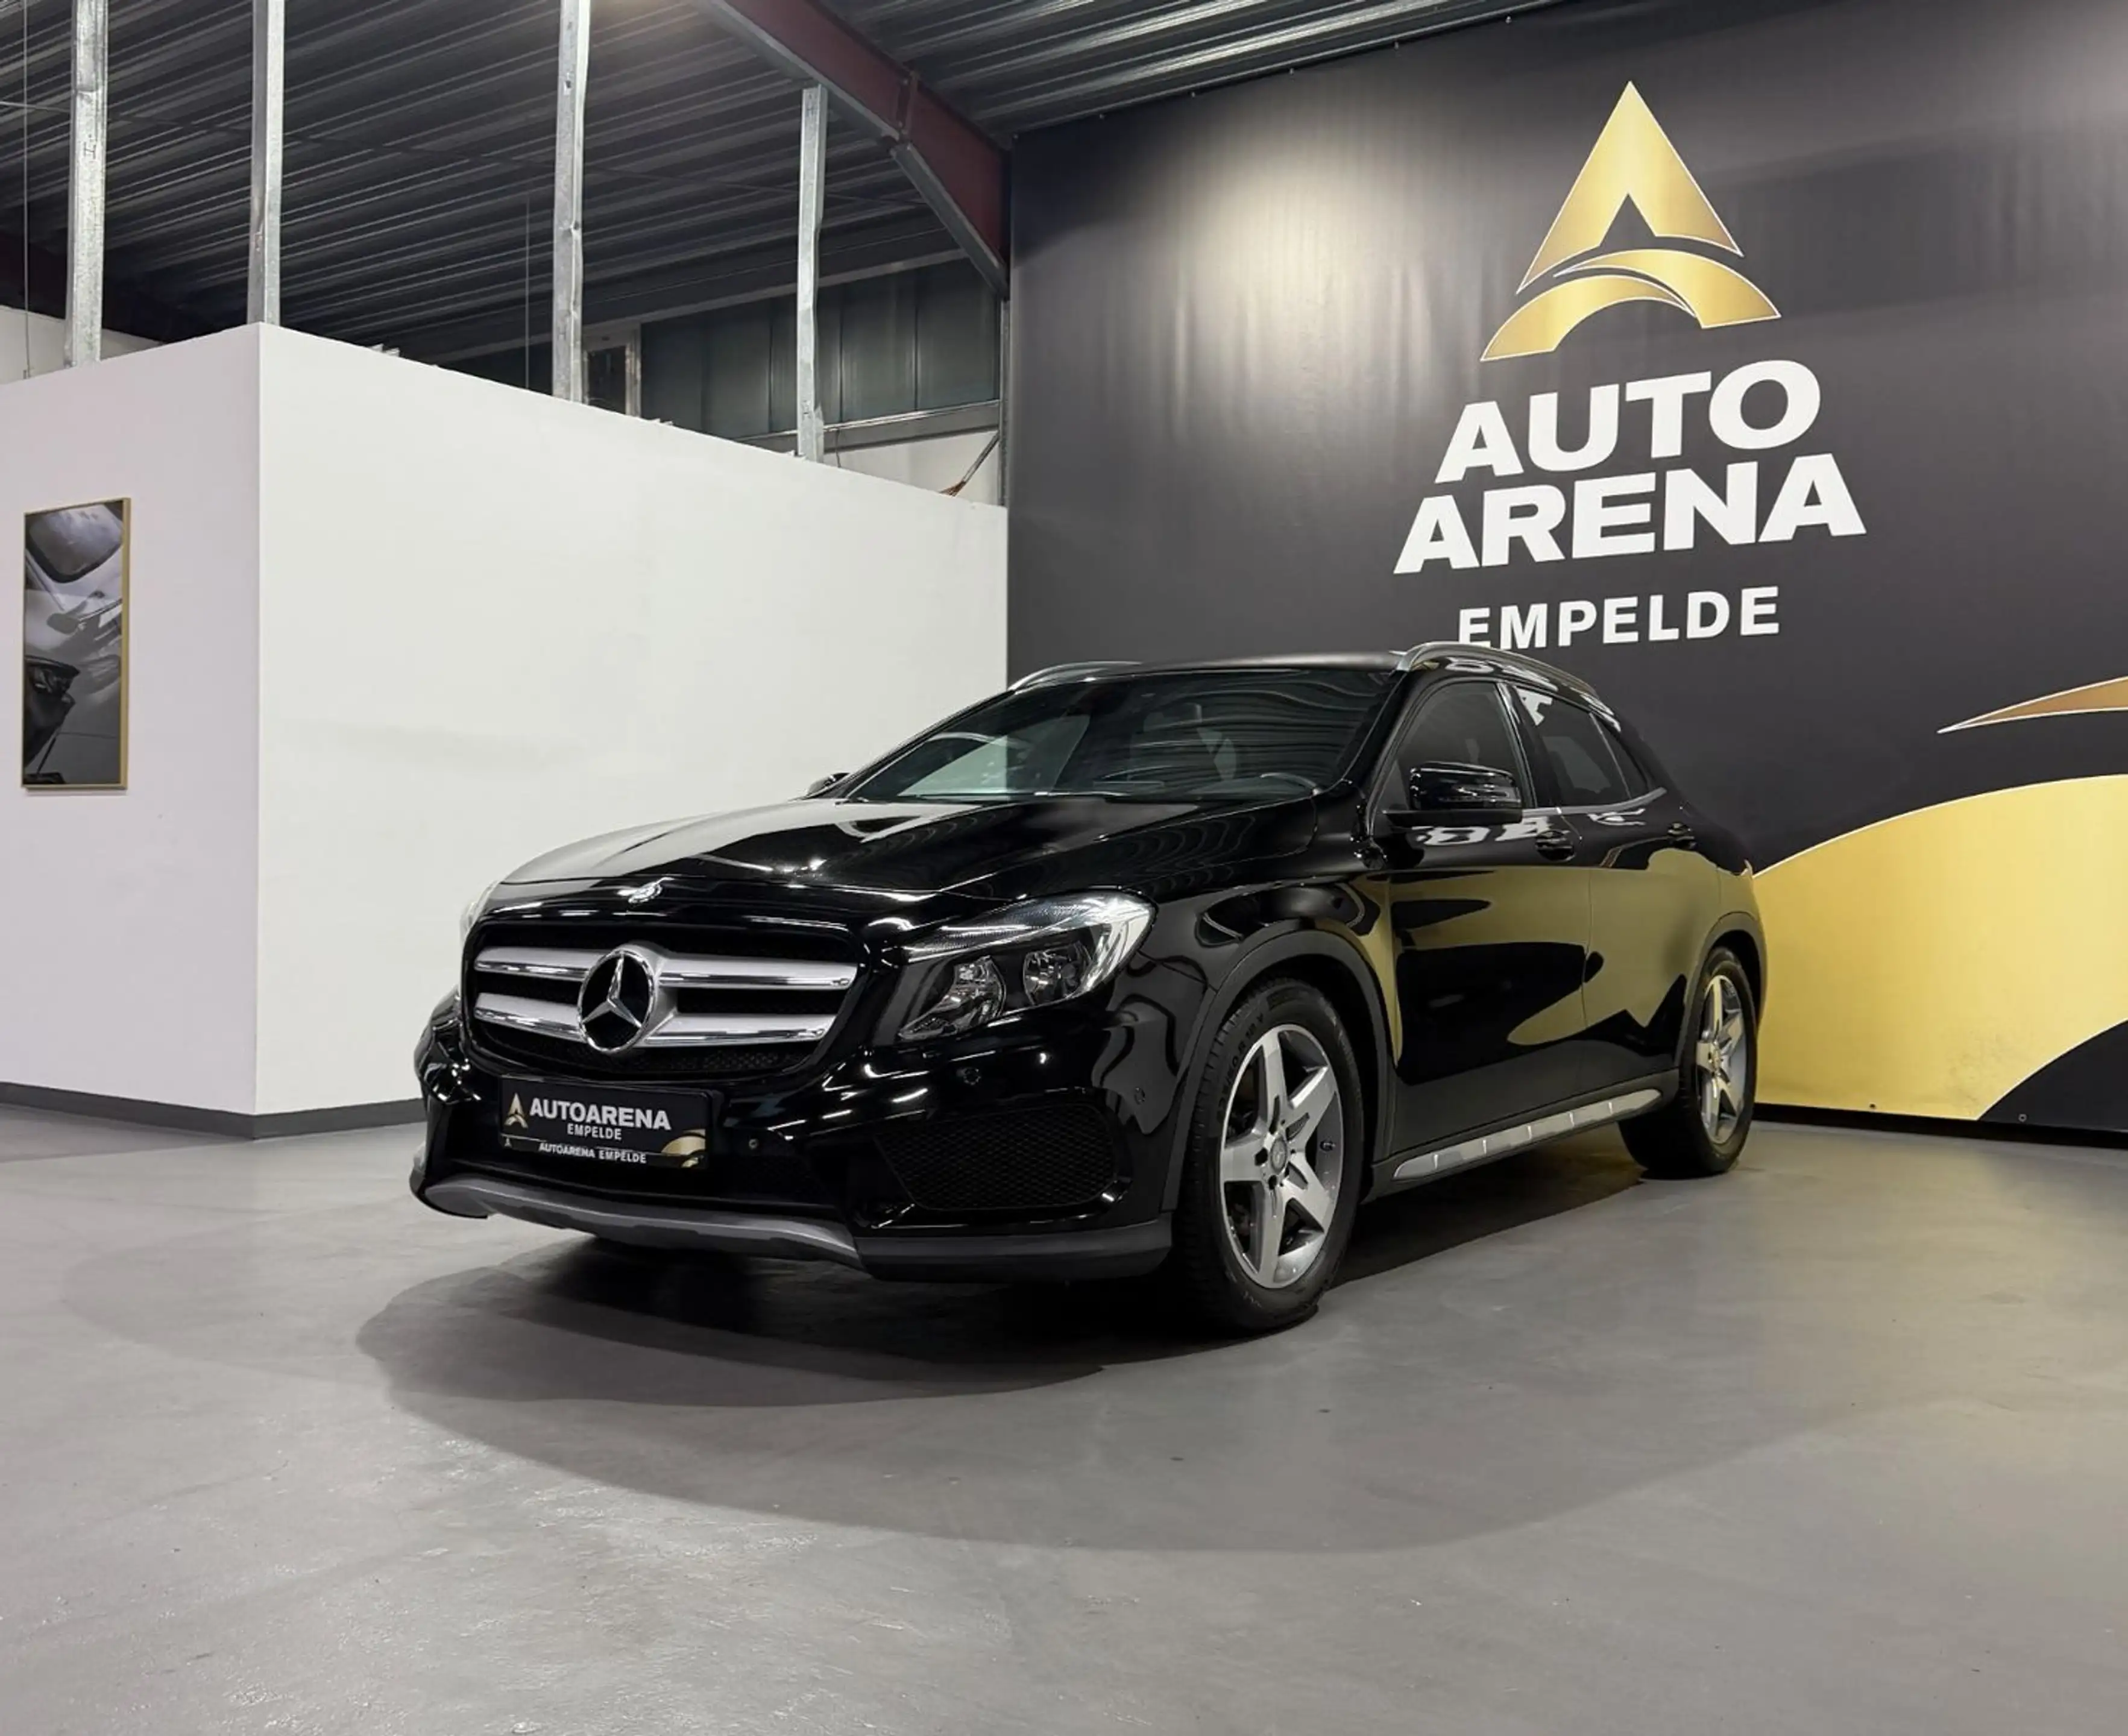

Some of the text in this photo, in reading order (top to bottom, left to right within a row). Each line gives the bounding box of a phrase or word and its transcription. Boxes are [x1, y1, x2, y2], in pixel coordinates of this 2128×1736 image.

[1435, 360, 1821, 483] AUTO
[1393, 453, 1866, 574] ARENA
[1459, 586, 1779, 650] EMPELDE
[529, 1098, 672, 1130] AUTOARENA
[567, 1123, 622, 1140] EMPELDE
[538, 1142, 647, 1164] AUTOARENA EMPELDE
